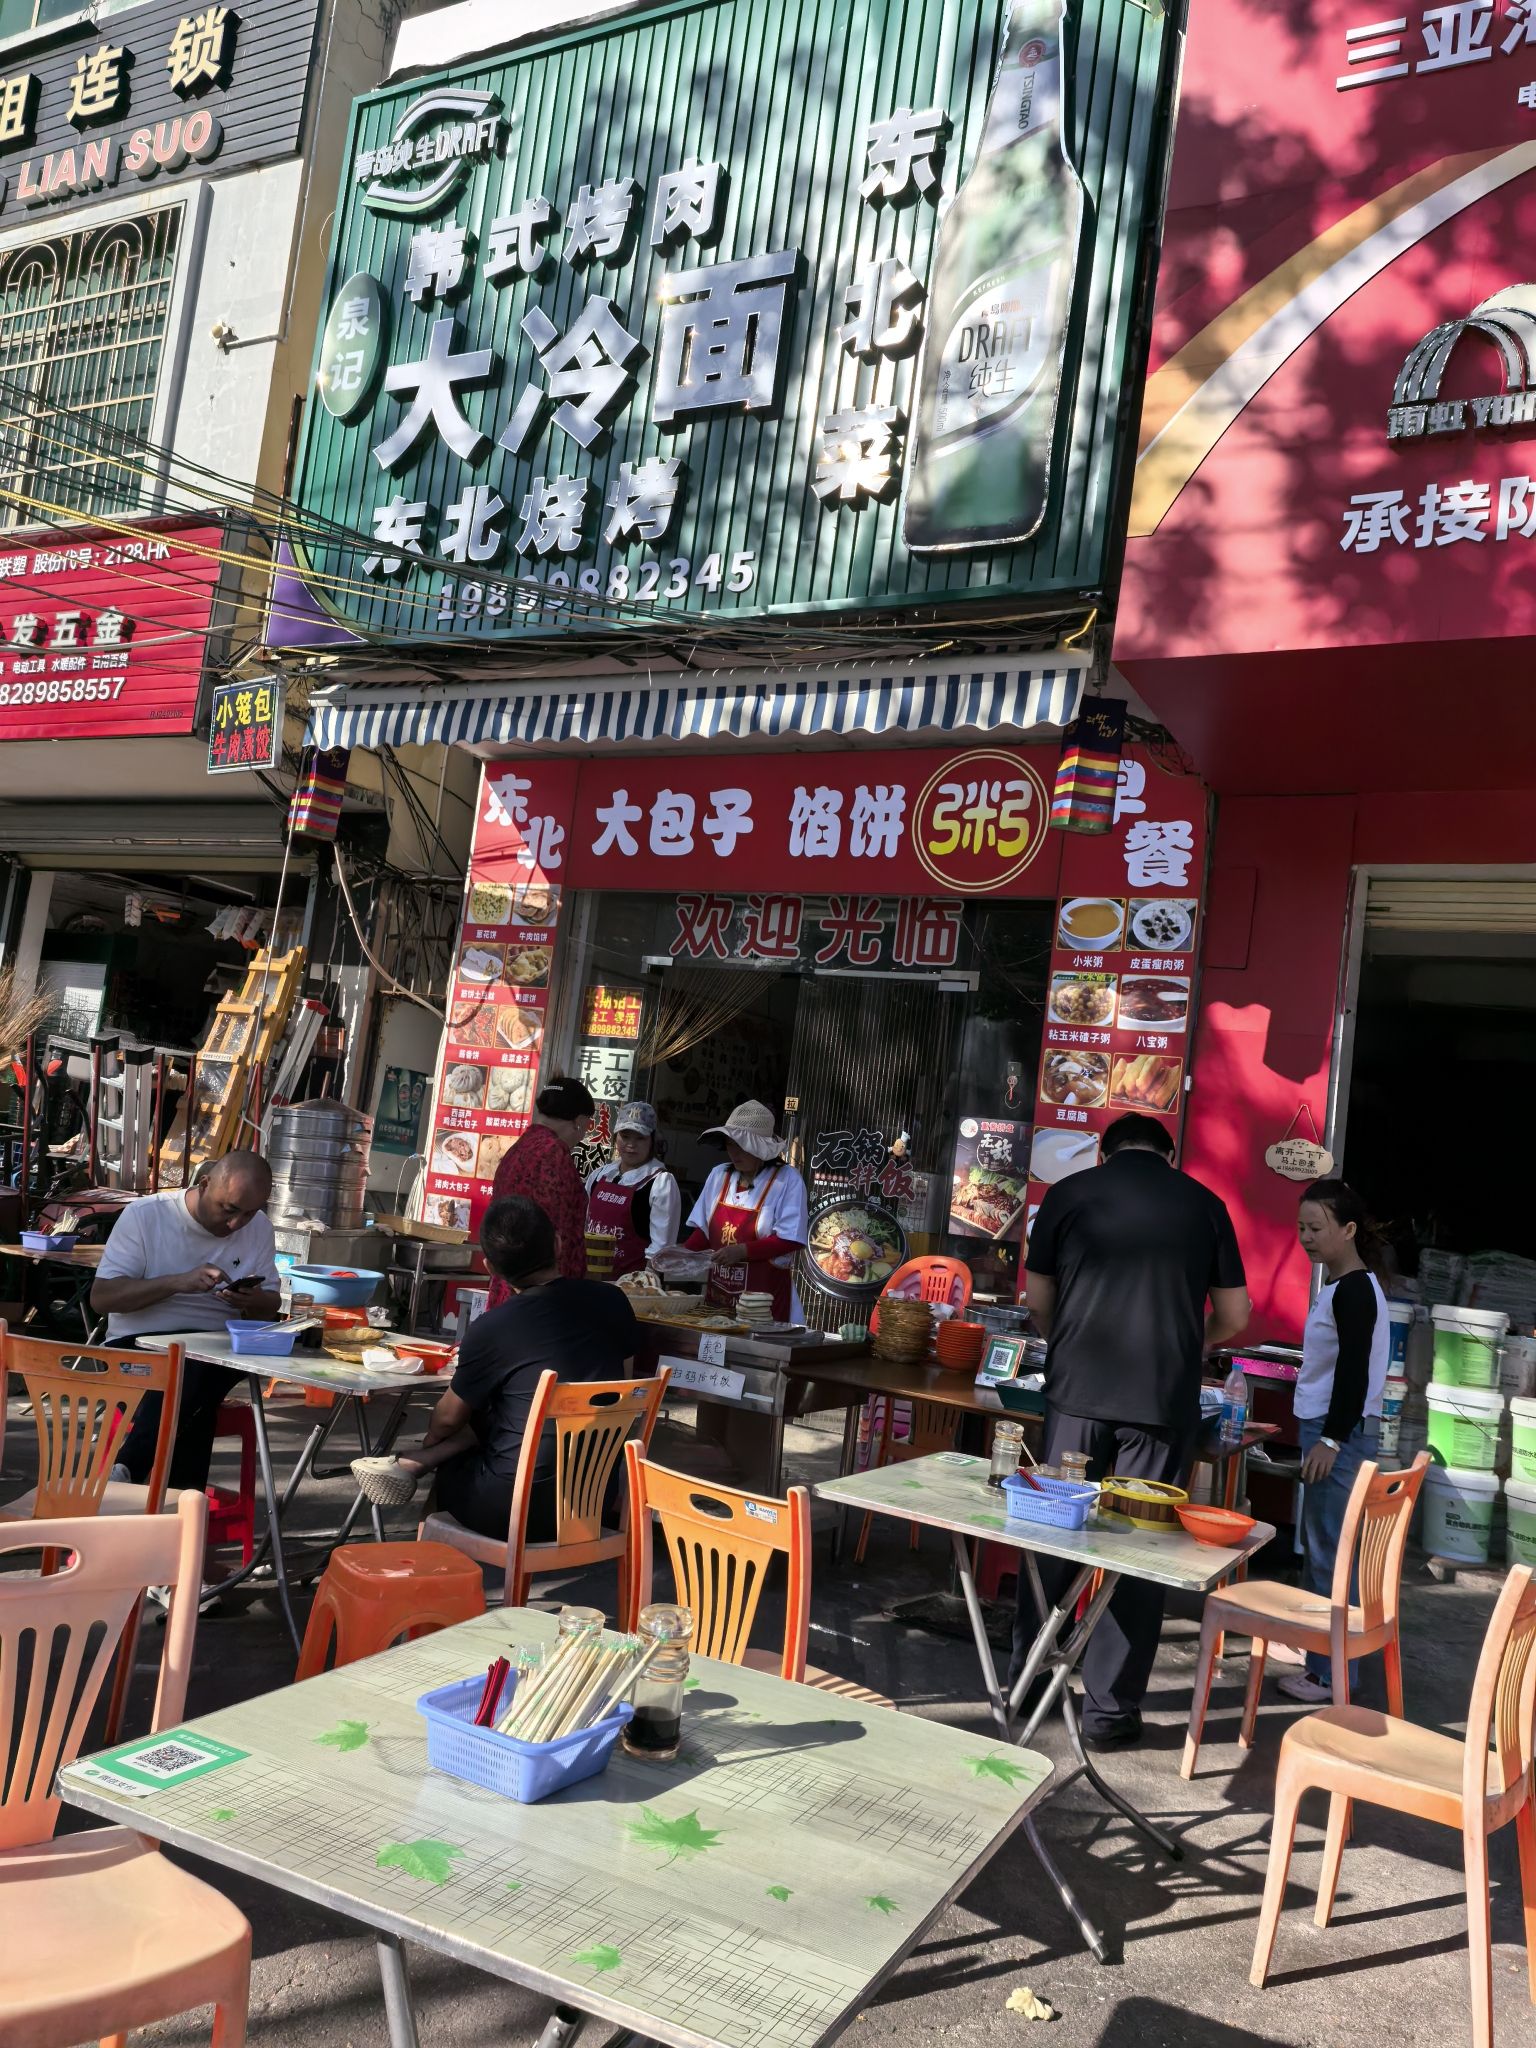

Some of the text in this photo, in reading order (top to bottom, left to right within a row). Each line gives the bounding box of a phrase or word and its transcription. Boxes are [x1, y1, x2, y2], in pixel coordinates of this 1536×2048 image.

[1018, 71, 1035, 129] TSINGTAO
[16, 111, 212, 199] LIAN SUO
[404, 158, 724, 301] 韩式烤肉
[811, 108, 946, 498] 东北菜
[331, 296, 369, 392] 泉记
[373, 247, 796, 469] 大冷面
[958, 316, 1032, 363] DRAFT
[968, 359, 1016, 399] 纯生
[362, 456, 681, 575] 东北烧烤
[216, 688, 271, 728] 小笼包
[484, 773, 564, 869] 东北
[591, 780, 1032, 858] 大包子 馅饼 粥
[670, 894, 964, 966] 欢迎光临
[1073, 955, 1185, 971] 小米粥 皮蛋瘦肉粥
[578, 1049, 629, 1072] 手工
[1136, 1035, 1168, 1049] 八宝粥
[579, 1073, 627, 1098] 水饺
[1056, 1108, 1088, 1123] 豆腐脑
[811, 1128, 886, 1169] 石锅
[1281, 1156, 1316, 1168] 马上回来
[848, 1159, 916, 1200] 拌饭
